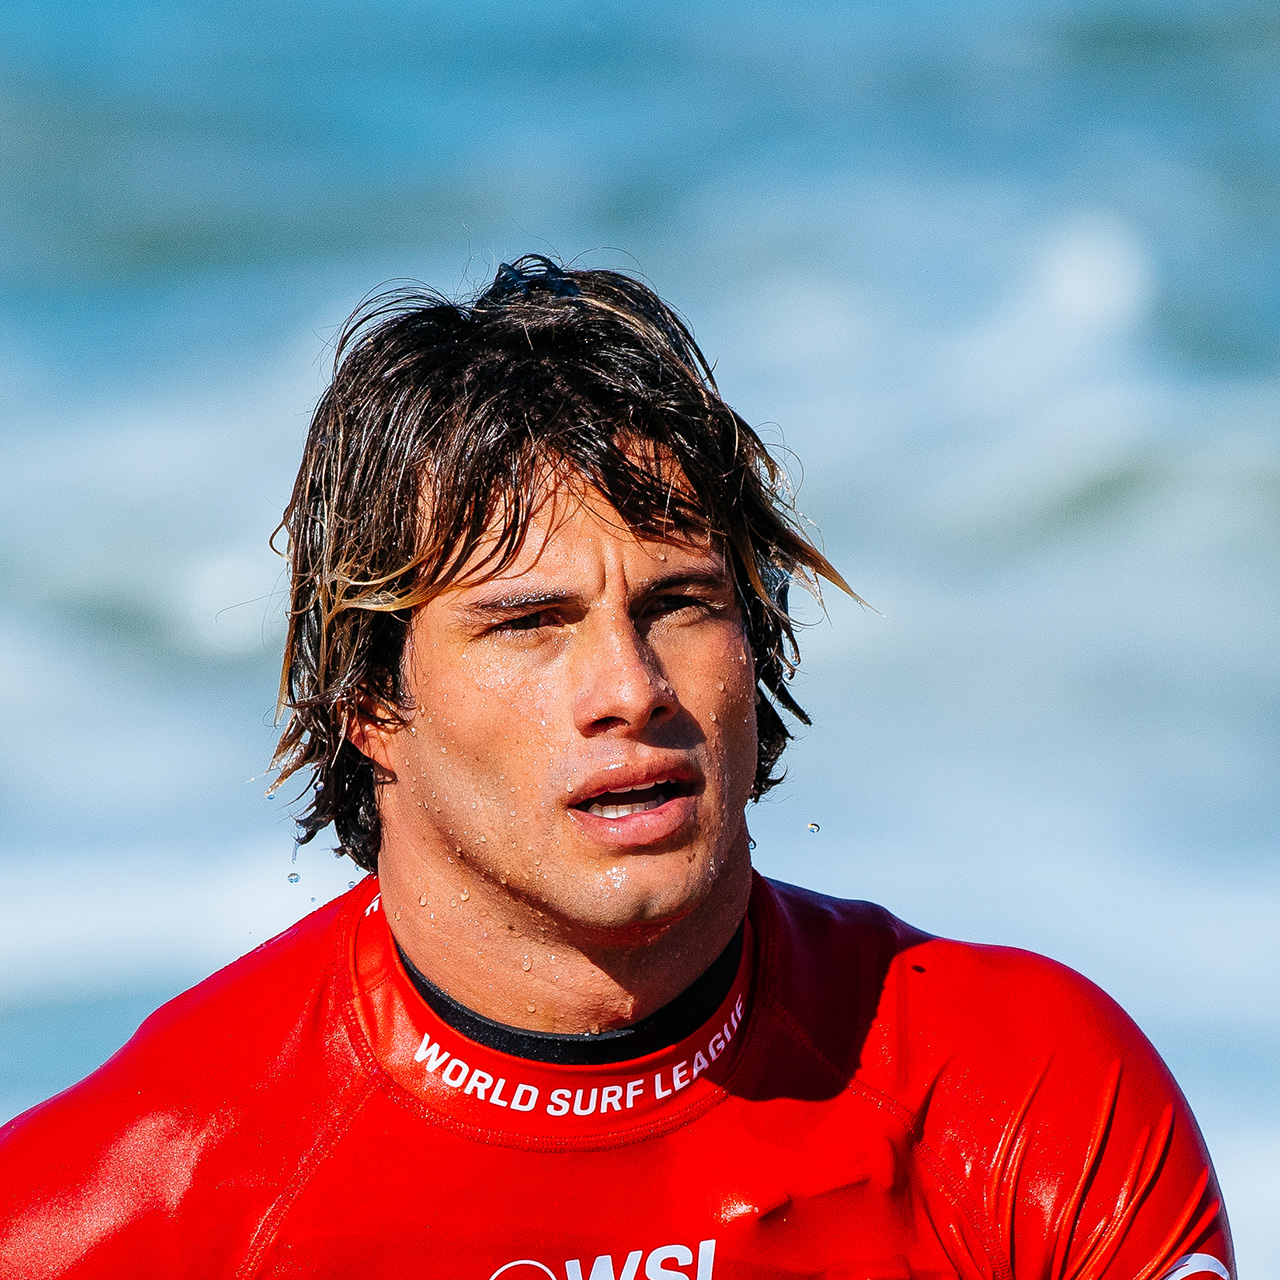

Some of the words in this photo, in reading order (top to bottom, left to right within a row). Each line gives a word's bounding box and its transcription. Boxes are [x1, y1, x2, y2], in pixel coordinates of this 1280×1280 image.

[413, 1032, 540, 1113] WORLD
[545, 1077, 645, 1118] SURF
[654, 992, 745, 1101] LEAGUE
